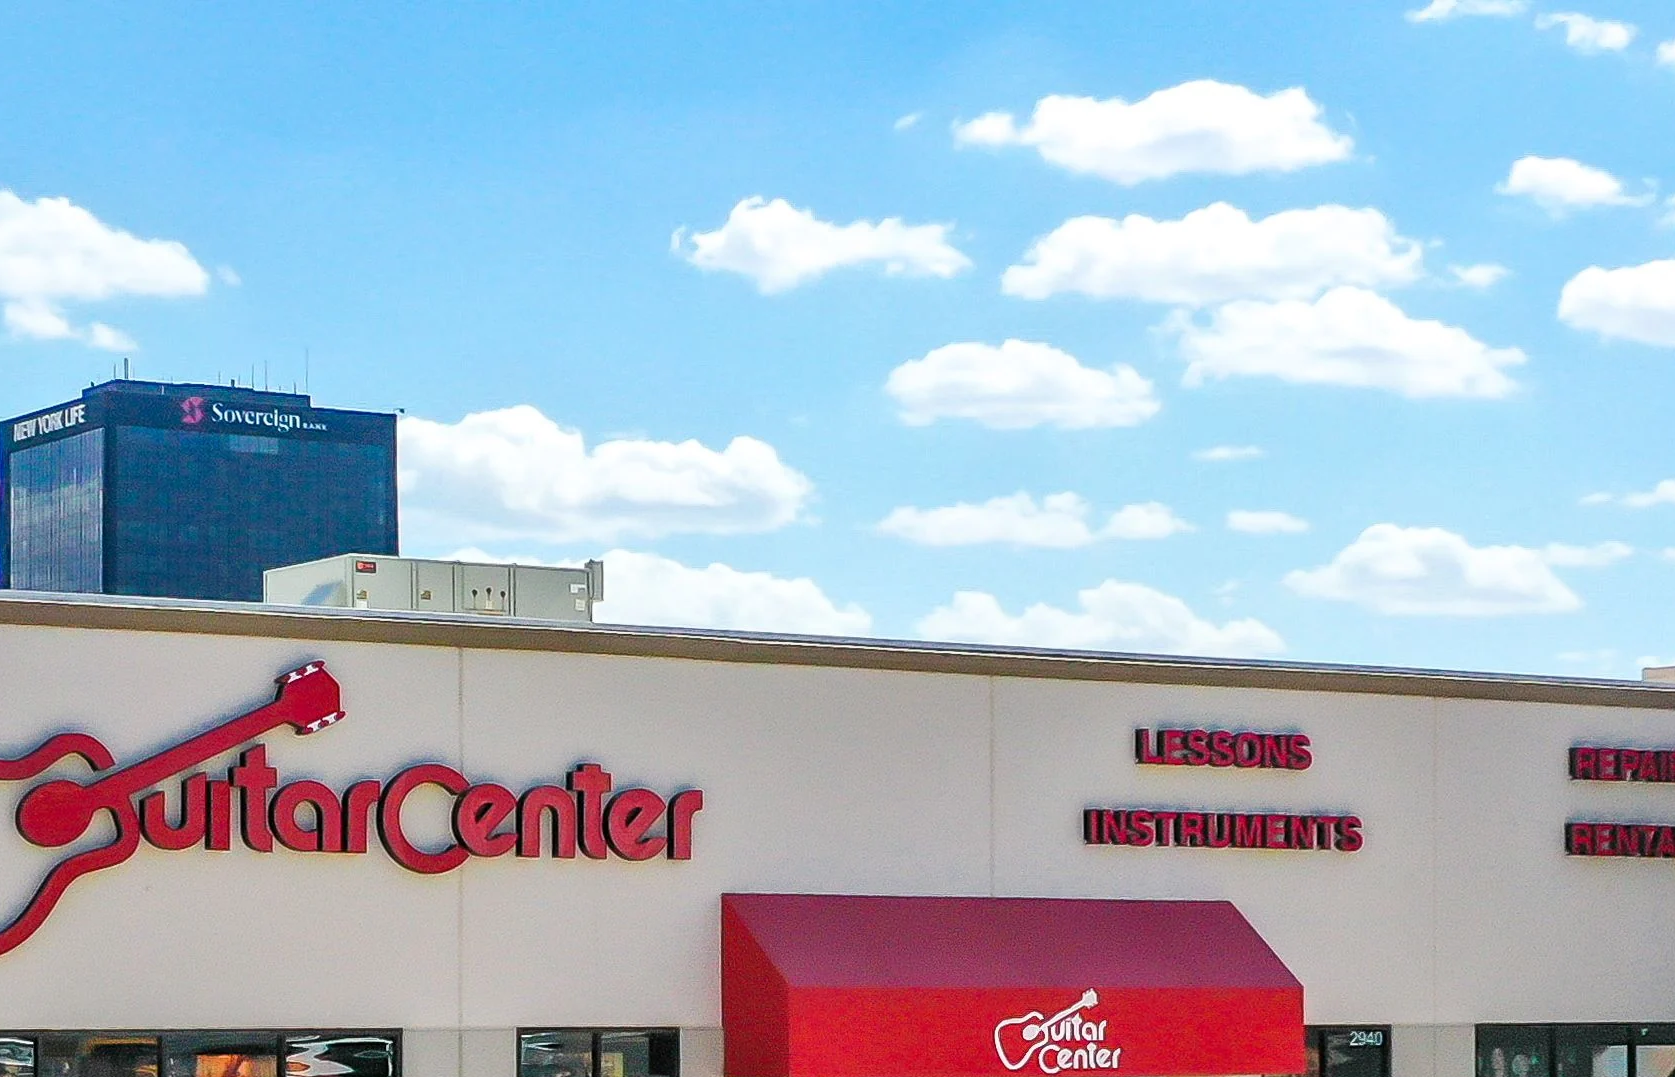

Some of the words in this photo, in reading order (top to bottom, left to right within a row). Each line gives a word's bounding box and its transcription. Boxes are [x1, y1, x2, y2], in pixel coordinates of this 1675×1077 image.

[13, 420, 36, 442] NEW
[36, 410, 63, 434] YORK
[63, 404, 86, 428] LIFE
[211, 402, 301, 432] Sovereign
[1134, 728, 1313, 770] LESSONS
[1083, 807, 1364, 852] INSTRUMENTS
[1349, 1031, 1383, 1046] 2940
[1038, 1043, 1121, 1074] Center
